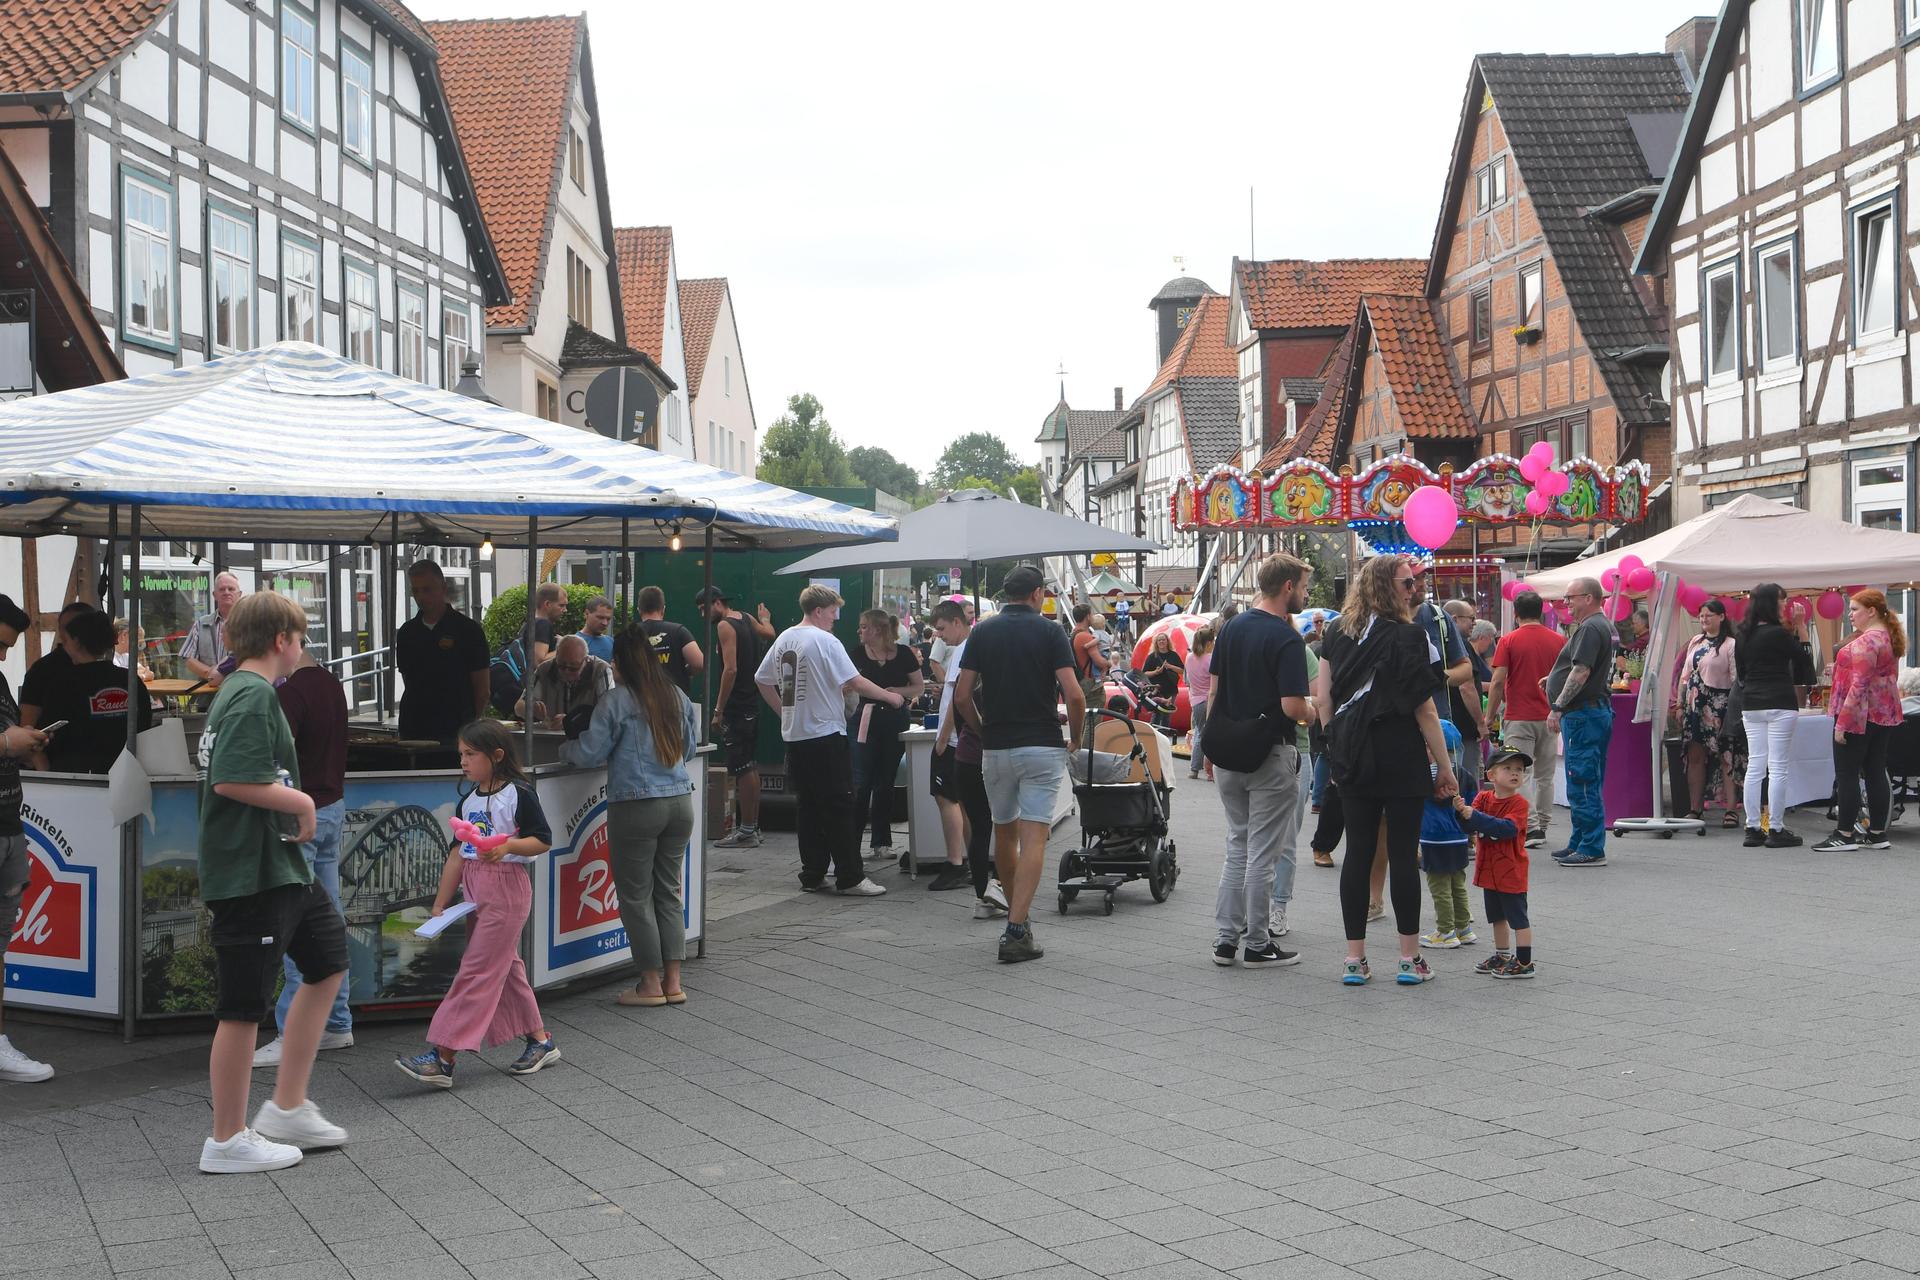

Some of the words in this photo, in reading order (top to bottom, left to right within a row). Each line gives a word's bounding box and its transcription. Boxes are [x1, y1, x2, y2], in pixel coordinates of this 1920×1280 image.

[20, 802, 74, 858] Rintelns
[564, 794, 598, 838] Älteste
[604, 932, 621, 950] seit
